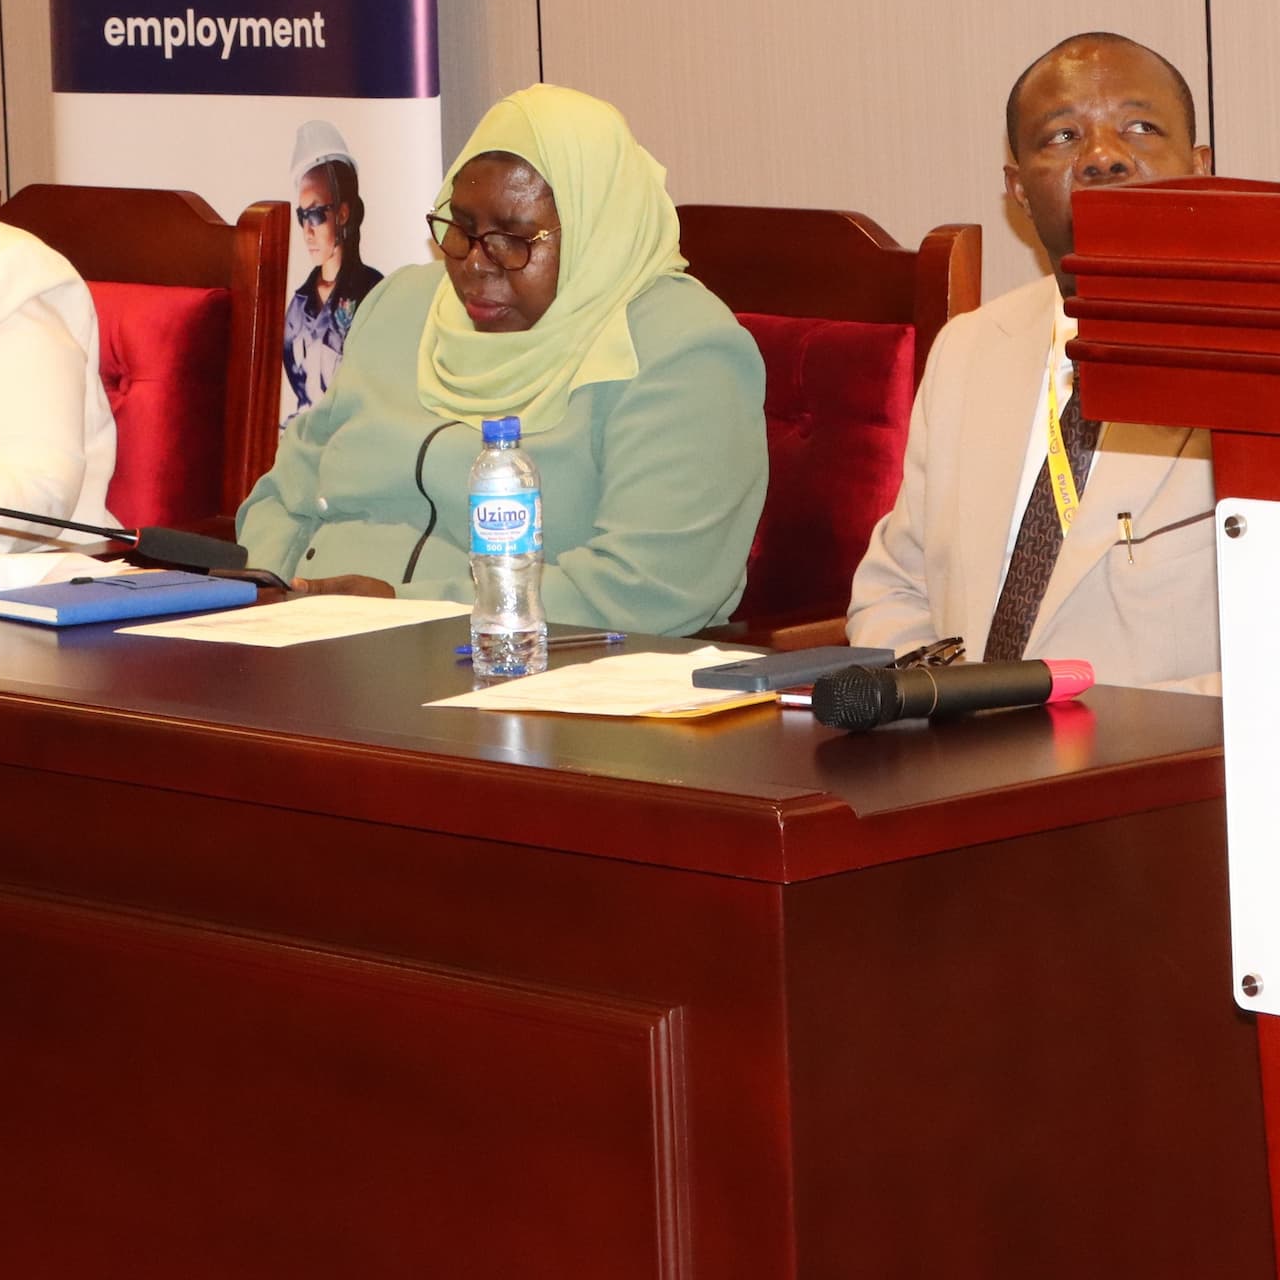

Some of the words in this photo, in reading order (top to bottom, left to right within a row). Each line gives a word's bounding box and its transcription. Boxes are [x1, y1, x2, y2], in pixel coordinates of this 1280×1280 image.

[104, 8, 326, 60] employment
[477, 506, 526, 522] Uzima
[486, 543, 502, 552] 500
